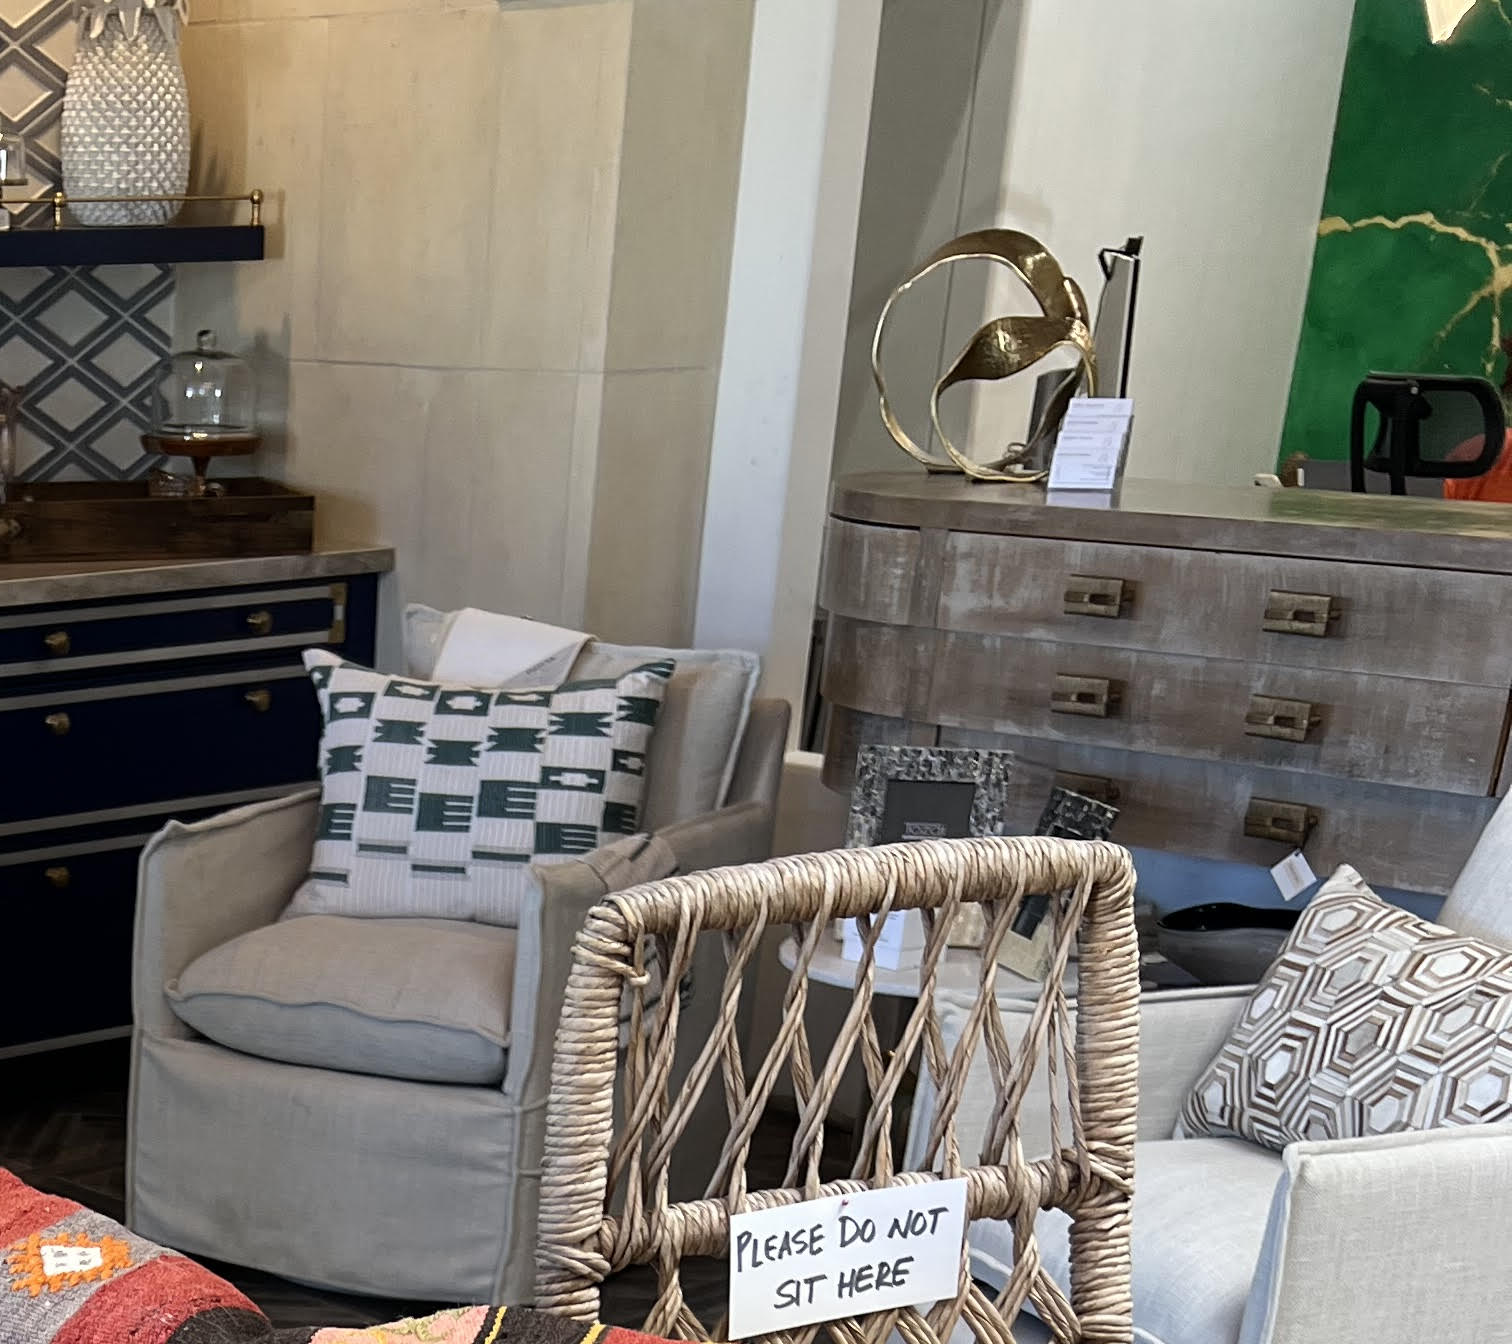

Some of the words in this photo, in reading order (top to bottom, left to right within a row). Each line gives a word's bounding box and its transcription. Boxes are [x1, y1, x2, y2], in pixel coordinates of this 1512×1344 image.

[736, 1223, 826, 1273] PLEASE
[838, 1215, 876, 1248] DO
[887, 1206, 949, 1240] NOT
[773, 1275, 828, 1309] SIT
[838, 1256, 914, 1299] HERE
